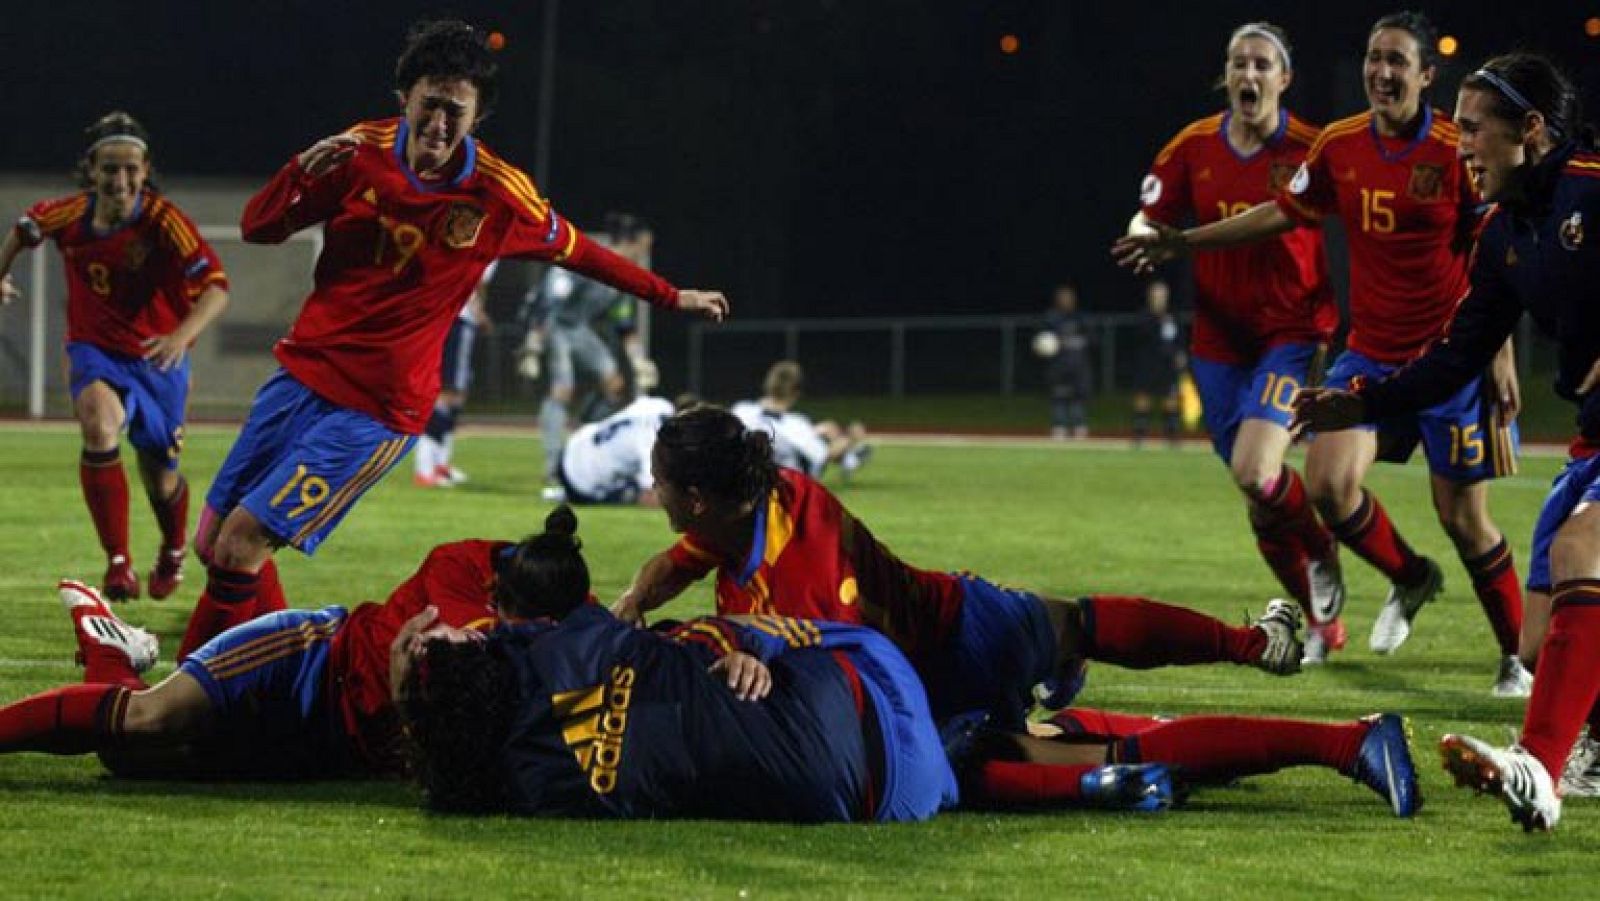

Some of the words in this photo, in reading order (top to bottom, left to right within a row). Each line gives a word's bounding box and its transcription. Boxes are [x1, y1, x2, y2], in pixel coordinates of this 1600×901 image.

[1360, 187, 1395, 232] 15
[375, 215, 424, 274] 19
[87, 261, 112, 297] 8
[1260, 372, 1299, 411] 10
[1449, 424, 1484, 466] 15
[271, 464, 330, 518] 19
[590, 664, 635, 794] adidas
